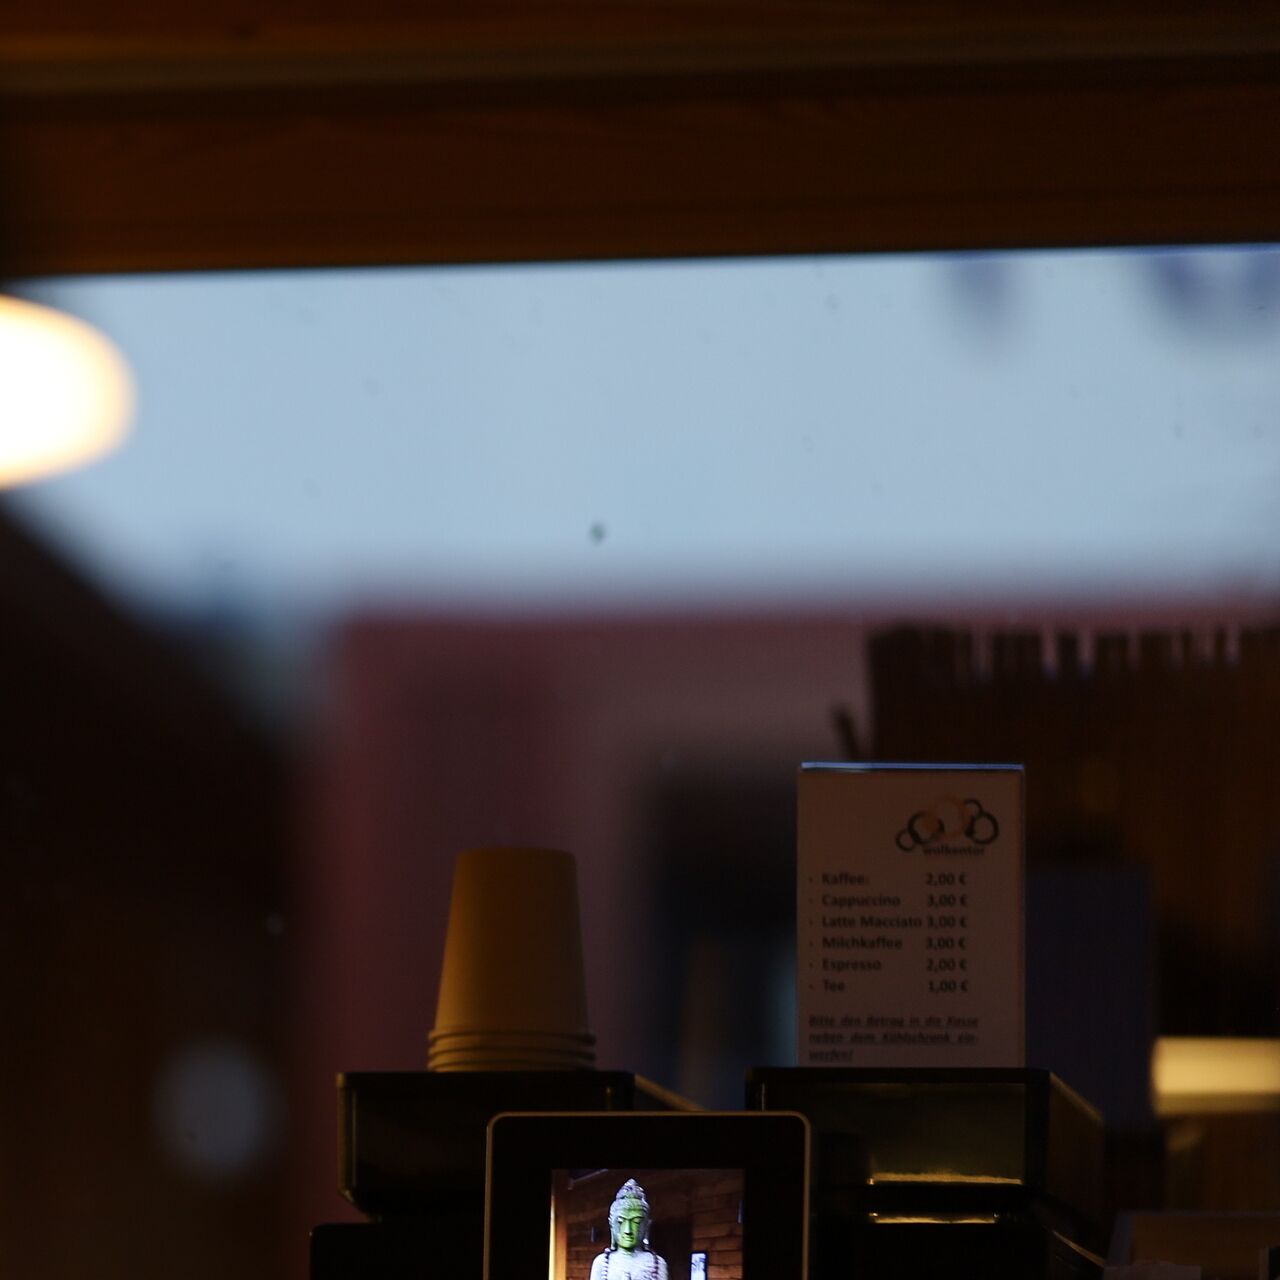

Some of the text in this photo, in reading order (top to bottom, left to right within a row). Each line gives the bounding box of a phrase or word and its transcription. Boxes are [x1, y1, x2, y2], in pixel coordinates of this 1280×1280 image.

[925, 872, 955, 887] 2,00
[958, 872, 967, 886] €
[821, 893, 968, 909] Cappuccino 3,00 €
[822, 915, 856, 929] Latte
[927, 914, 956, 930] 3,00
[959, 914, 968, 929] €
[822, 935, 966, 951] Milchkaffee 3,00 €
[926, 957, 956, 973] 2,00
[959, 957, 967, 972] €
[823, 978, 969, 995] Tee 1,00 €
